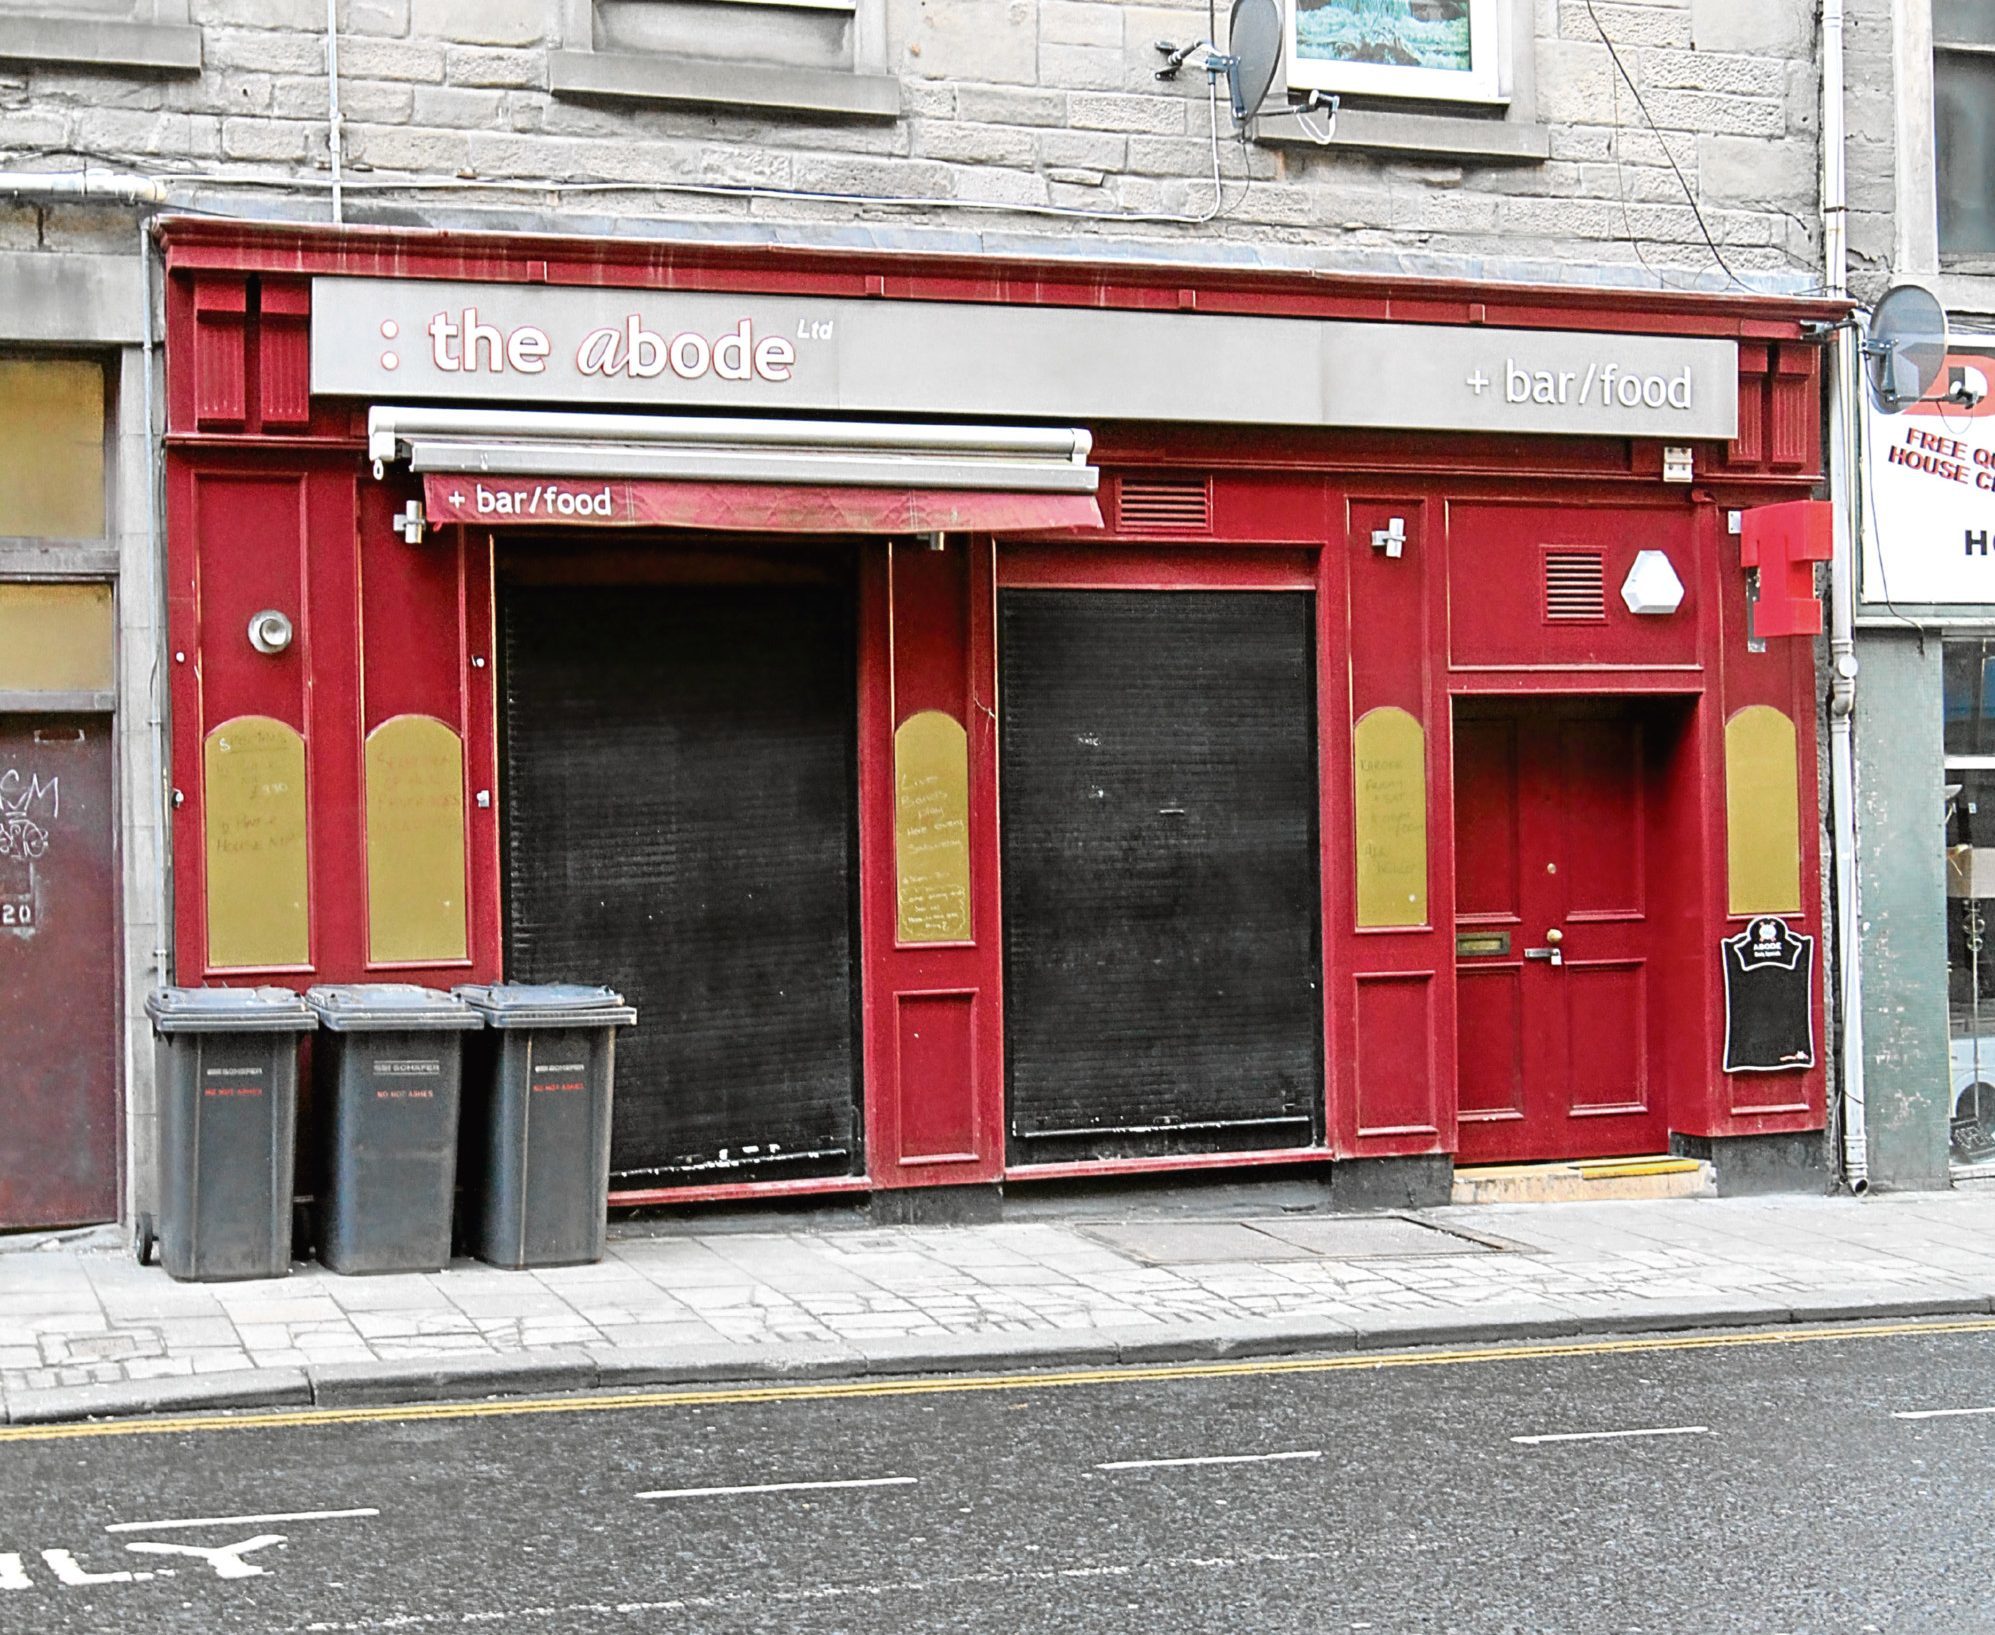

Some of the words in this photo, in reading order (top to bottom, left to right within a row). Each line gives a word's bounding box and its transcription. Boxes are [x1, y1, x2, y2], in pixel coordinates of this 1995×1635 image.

[428, 306, 551, 374] the
[576, 313, 796, 381] abode
[797, 318, 834, 340] Ltd
[1506, 358, 1692, 409] bar/food
[1906, 427, 1968, 461] FREE
[1888, 445, 1971, 485] HOUSE
[476, 483, 613, 516] bar/food
